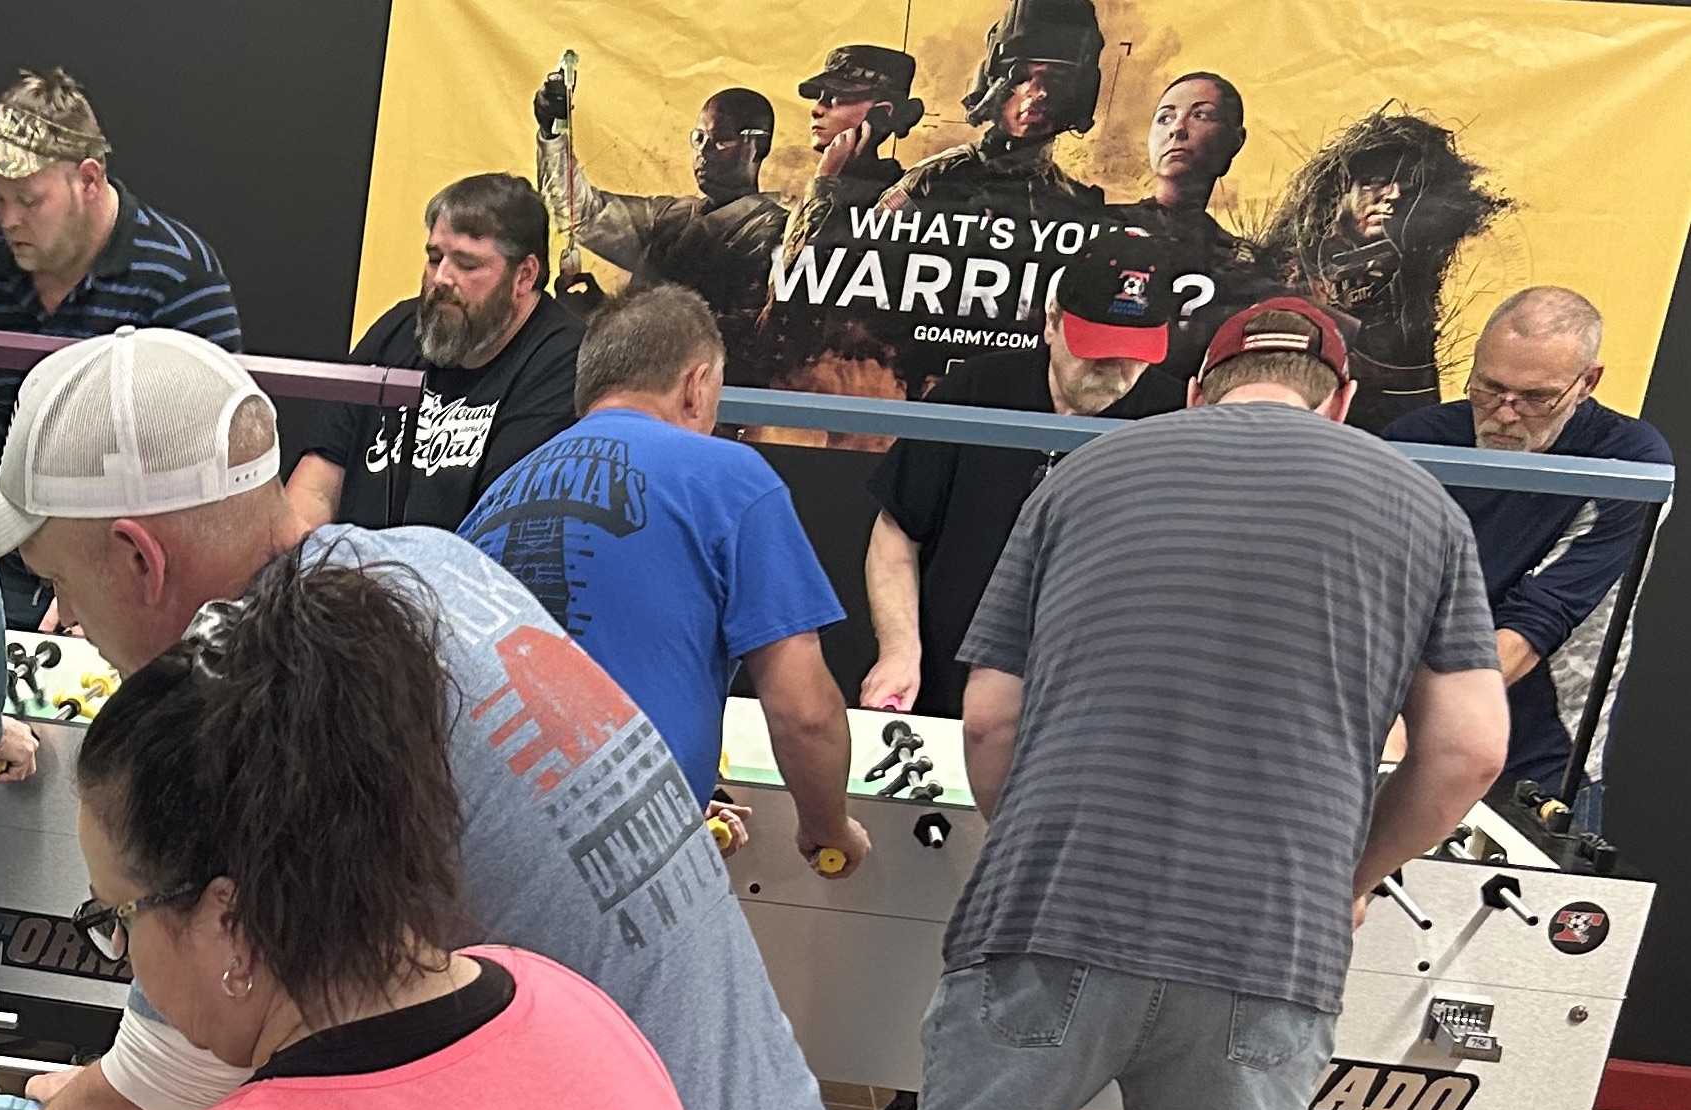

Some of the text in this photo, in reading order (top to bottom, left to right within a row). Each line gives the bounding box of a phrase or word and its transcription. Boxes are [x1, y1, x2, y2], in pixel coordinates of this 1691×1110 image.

[849, 205, 1150, 255] WHAT'S YO
[771, 244, 1216, 332] WARRI?
[913, 324, 1039, 350] GOARMY.COM
[579, 779, 693, 900] UNITING
[614, 832, 725, 950] ANGLE
